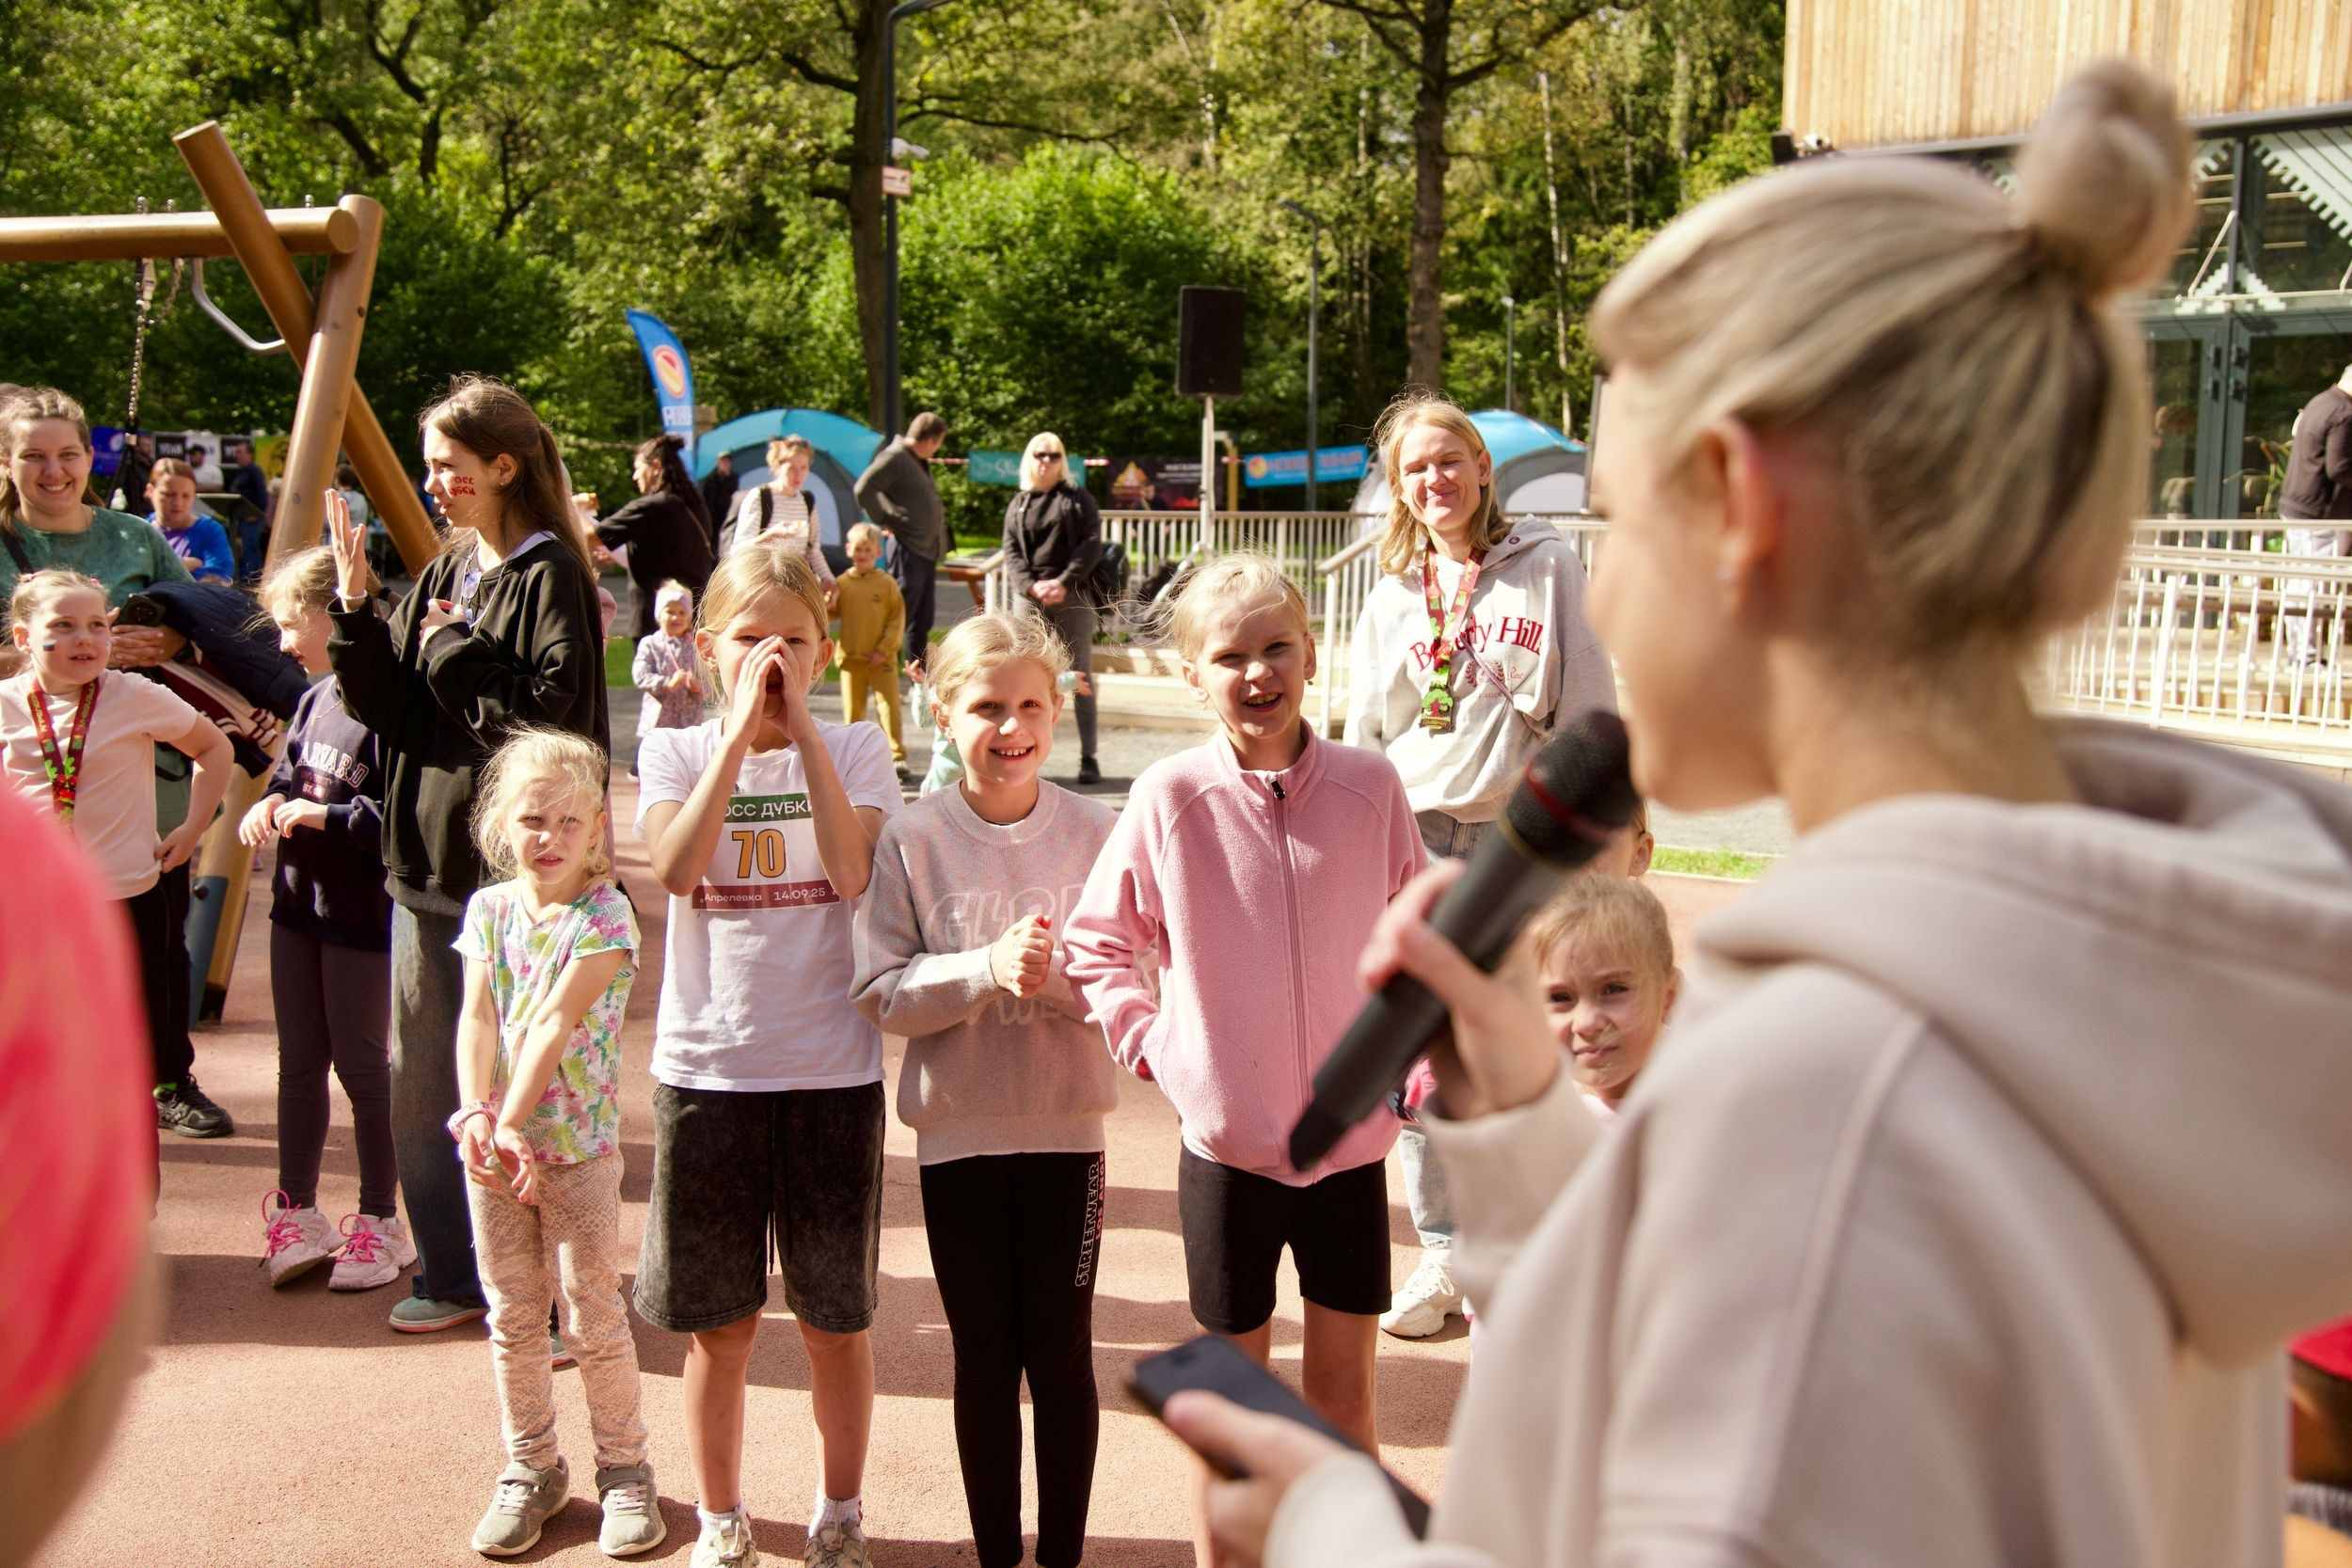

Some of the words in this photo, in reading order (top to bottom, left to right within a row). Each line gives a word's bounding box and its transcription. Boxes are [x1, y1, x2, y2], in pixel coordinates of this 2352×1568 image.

[1409, 614, 1491, 672] Berly
[1496, 616, 1543, 656] Hill
[294, 741, 370, 788] ARVARD
[731, 829, 787, 879] 70
[704, 893, 762, 903] Апрелевка
[773, 887, 826, 901] 14.09.25
[1075, 1161, 1100, 1287] STREETWEAR
